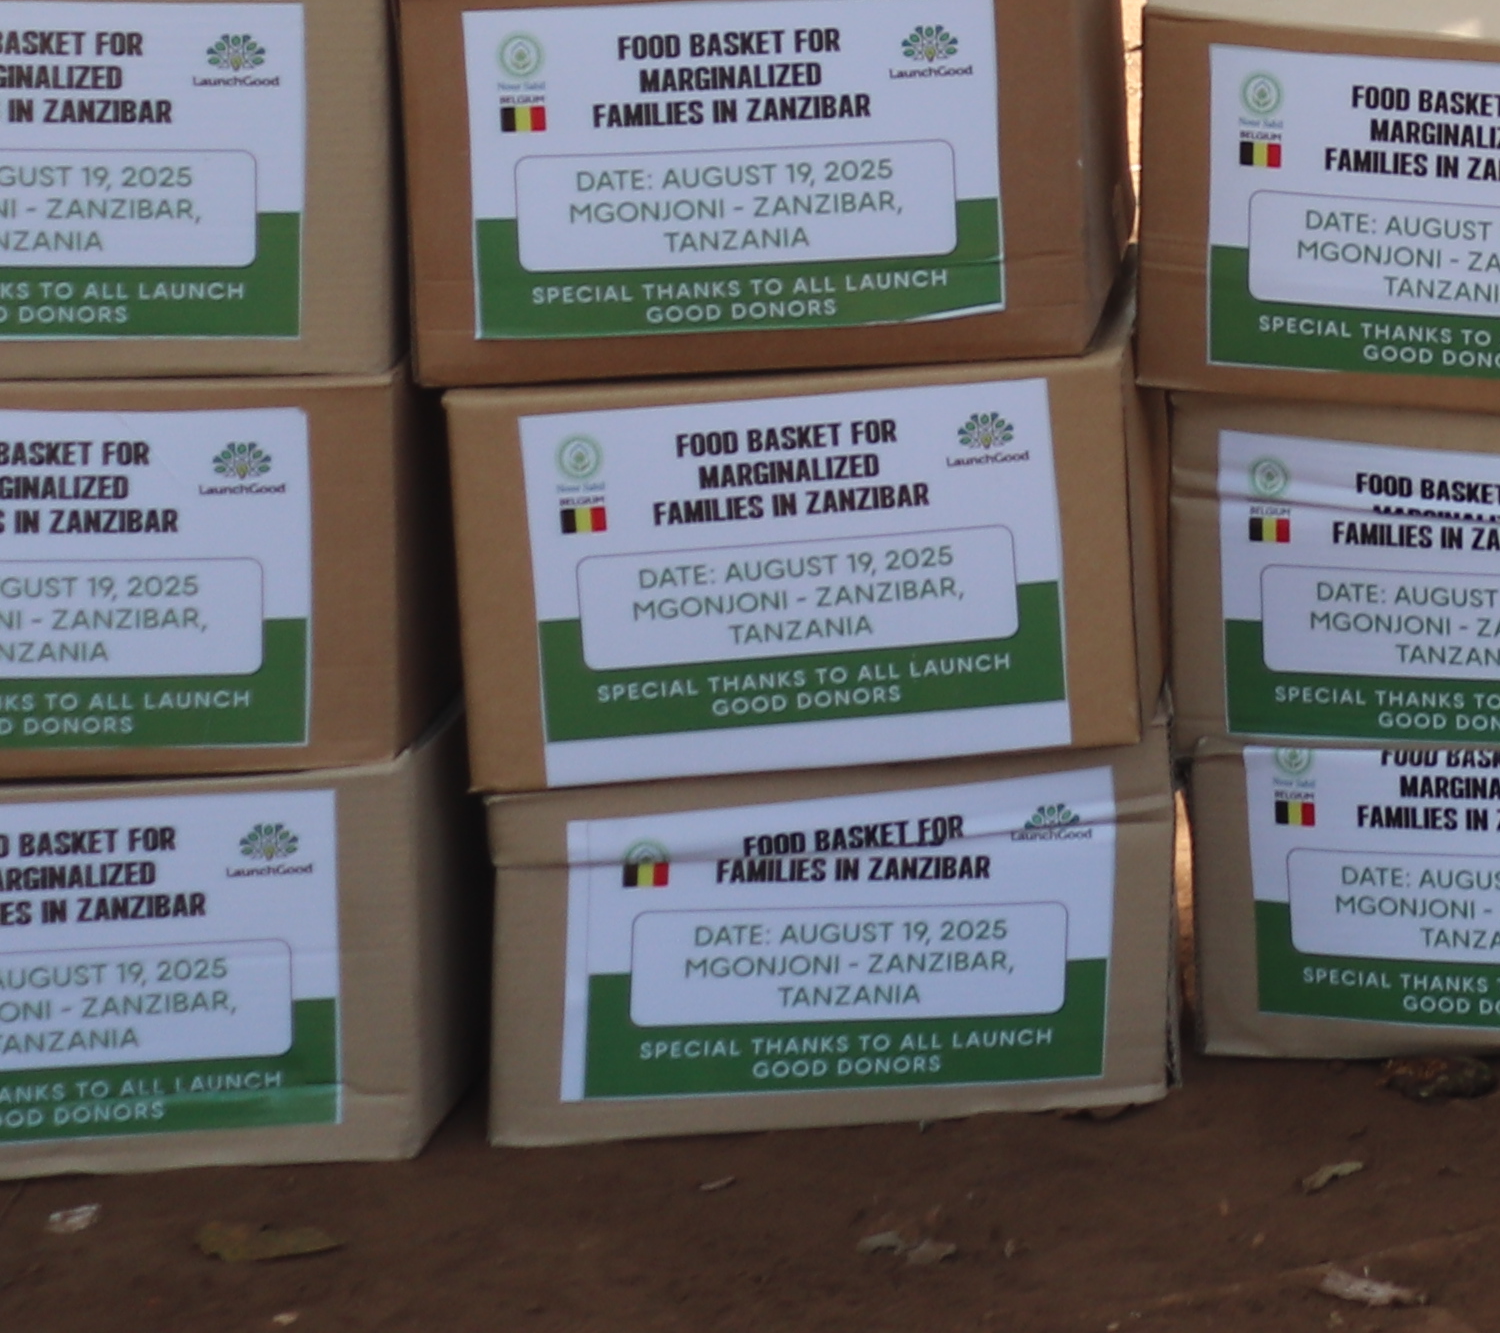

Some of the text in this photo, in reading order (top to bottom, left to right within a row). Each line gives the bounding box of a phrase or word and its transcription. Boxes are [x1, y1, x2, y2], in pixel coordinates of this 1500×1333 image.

[616, 27, 841, 61] FOOD BASKET FOR
[193, 75, 281, 88] LaunchGood
[638, 61, 823, 93] MARGINALIZED
[889, 64, 975, 81] LaunchGood
[592, 92, 872, 129] FAMILIES IN ZANZIBAR
[82, 165, 193, 191] 19, 2025
[1305, 209, 1378, 234] DATE:
[1385, 214, 1493, 242] AUGUST
[1297, 239, 1443, 269] MGONJONI
[1331, 522, 1434, 548] FAMILIES
[1440, 526, 1463, 549] IN
[638, 544, 954, 590] DATE: AUGUST 19, 2025
[632, 589, 789, 623] MGONJONI
[814, 575, 965, 612] ZANZIBAR,
[45, 689, 250, 711] TO ALL LAUNCH
[18, 825, 177, 857] BASKET FOR
[1301, 970, 1392, 990] SPECIAL
[1399, 973, 1489, 993] THANKS
[639, 1028, 1053, 1060] SPECIAL THANKS TO ALL LAUNCH
[752, 1055, 942, 1079] GOOD DONORS
